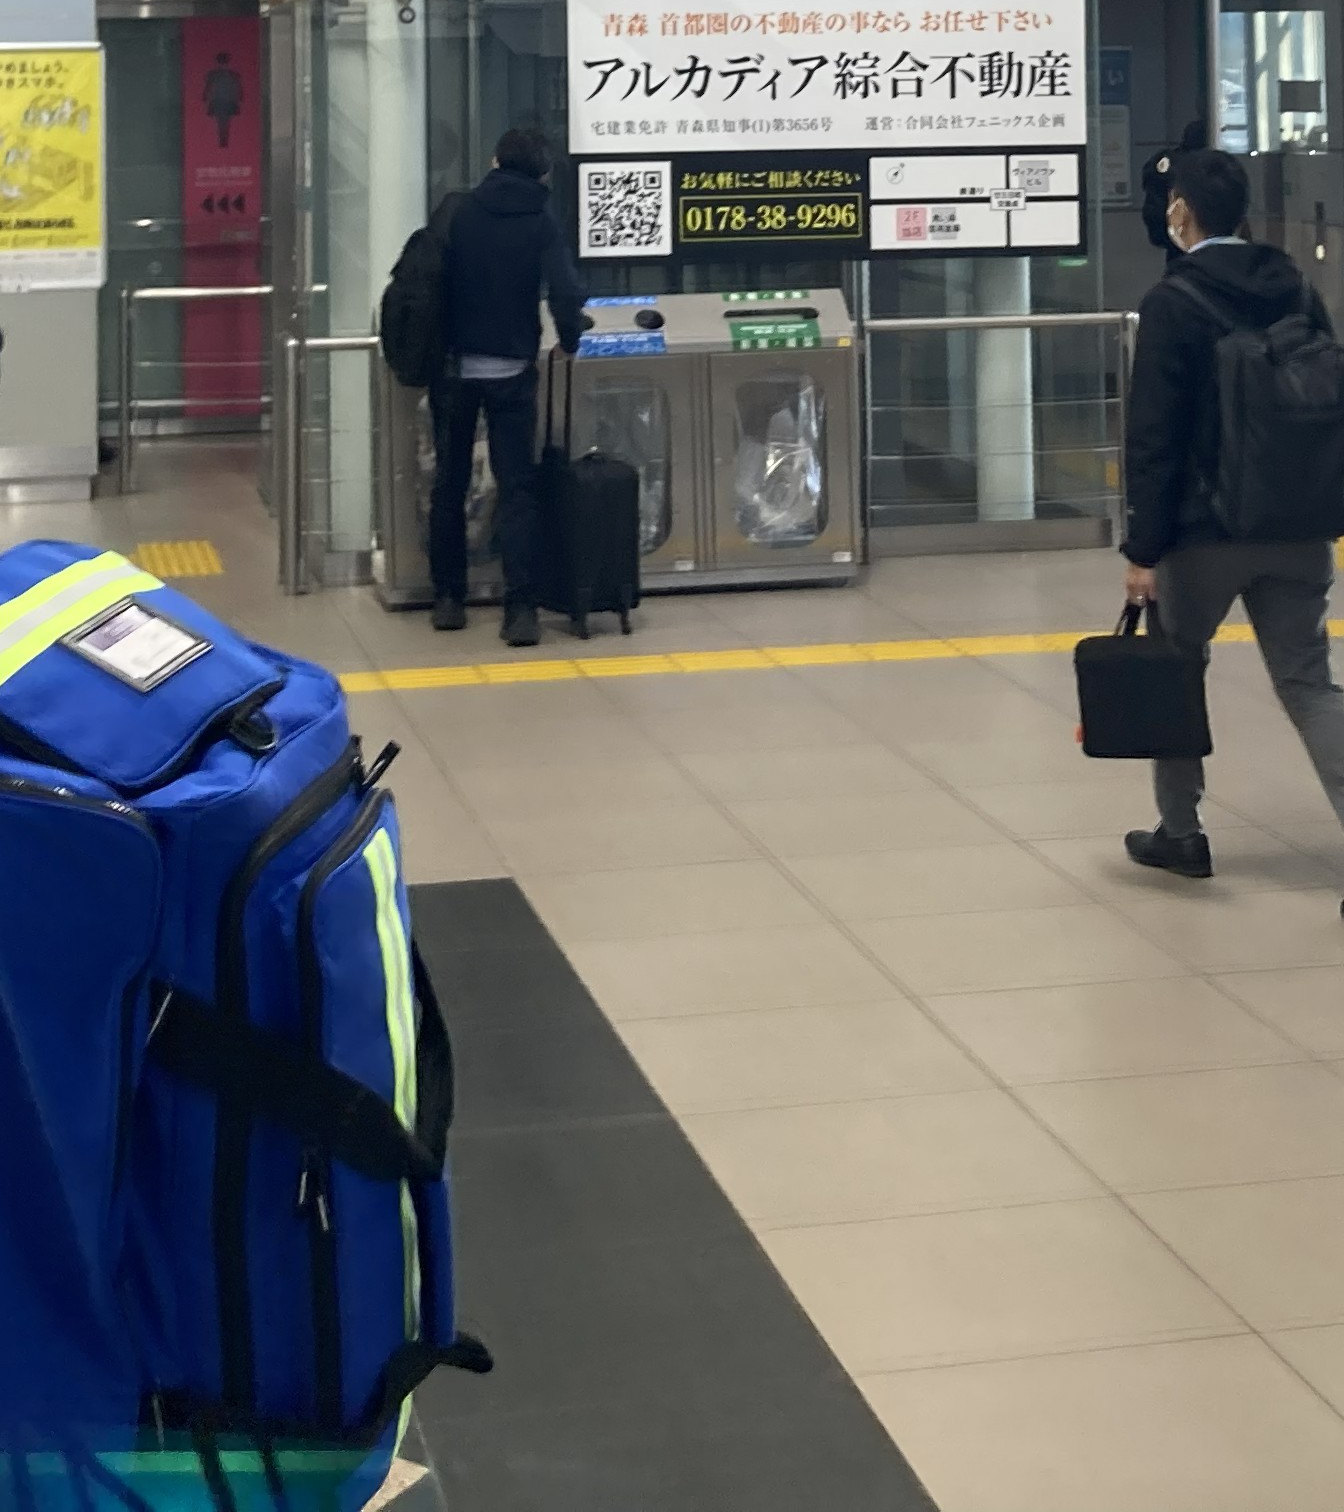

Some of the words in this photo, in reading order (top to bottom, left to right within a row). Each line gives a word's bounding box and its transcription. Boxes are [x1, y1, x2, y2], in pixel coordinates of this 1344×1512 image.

[602, 14, 649, 37] 青森
[920, 10, 1053, 33] お任せ下さい
[583, 49, 1072, 102] アルカディア綜合不動産
[681, 170, 861, 190] お気軽にご相談ください
[686, 203, 857, 232] 0178-38-9296
